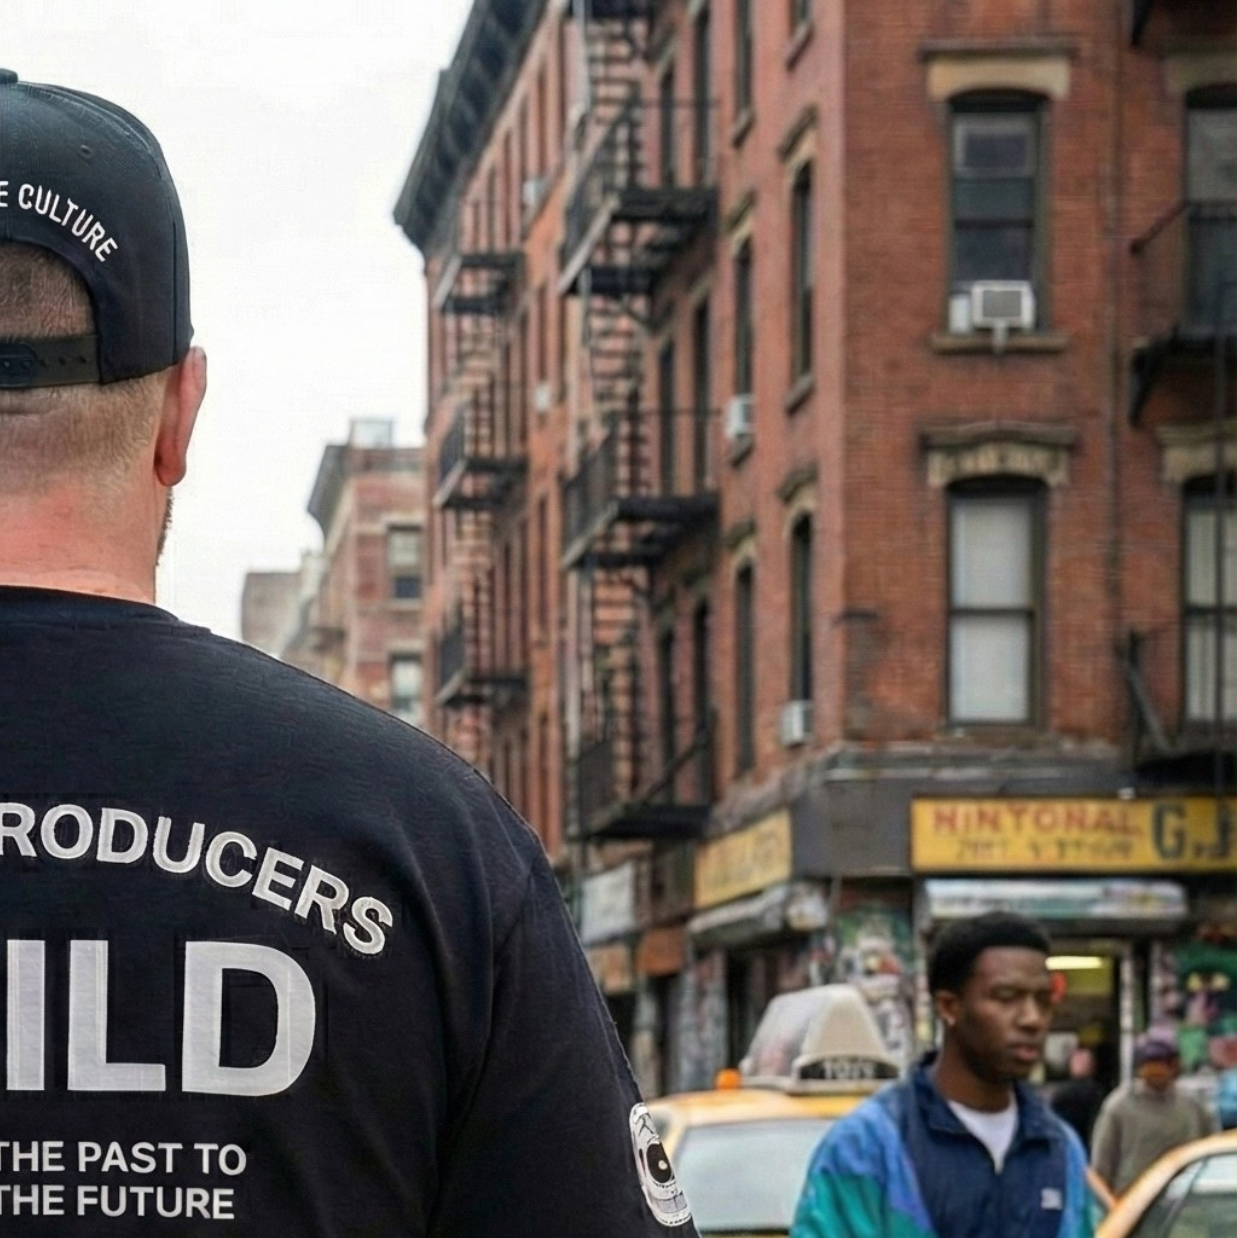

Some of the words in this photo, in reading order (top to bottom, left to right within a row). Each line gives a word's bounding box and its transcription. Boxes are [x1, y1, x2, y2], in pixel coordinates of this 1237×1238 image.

[18, 183, 119, 262] CULTURE
[78, 1141, 183, 1174] PAST
[193, 1143, 247, 1176] TO
[77, 1185, 235, 1220] FUTURE
